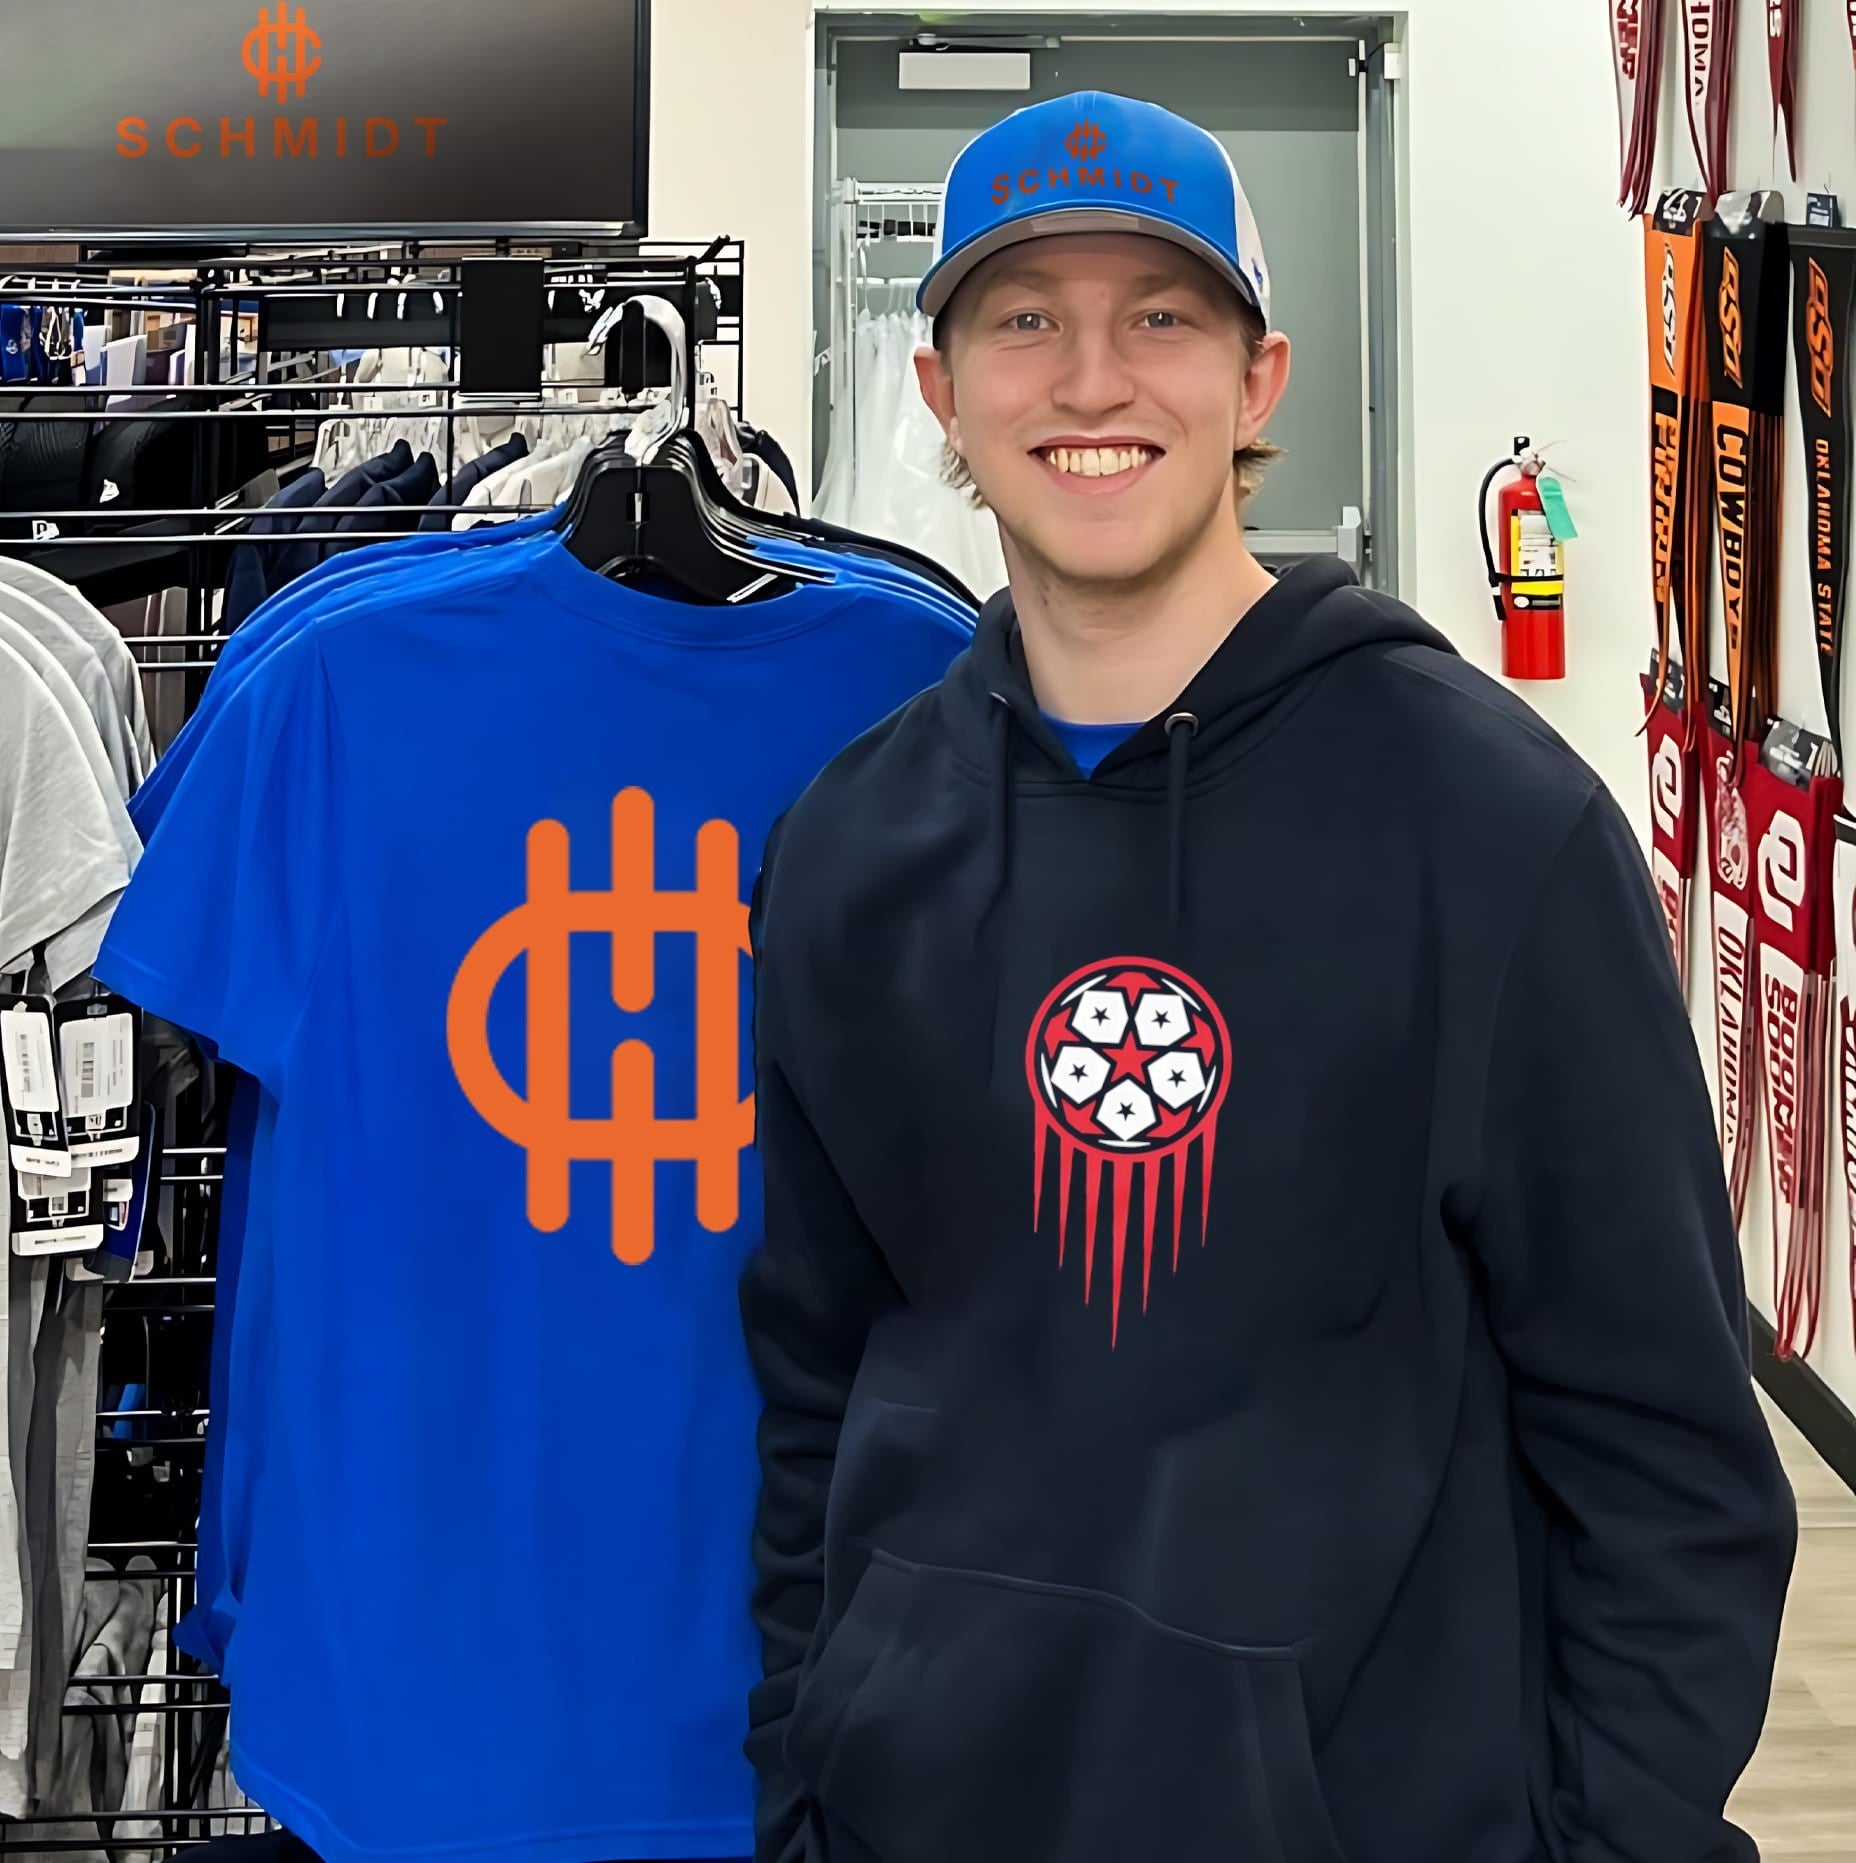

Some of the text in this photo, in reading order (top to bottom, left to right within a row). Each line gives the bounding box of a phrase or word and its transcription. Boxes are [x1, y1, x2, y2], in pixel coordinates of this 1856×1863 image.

[116, 117, 447, 158] SCHMIDT
[991, 167, 1179, 205] SCHMIDT
[1815, 438, 1832, 570] OKLAHOMA
[1718, 926, 1744, 1143] OKLAHOMA
